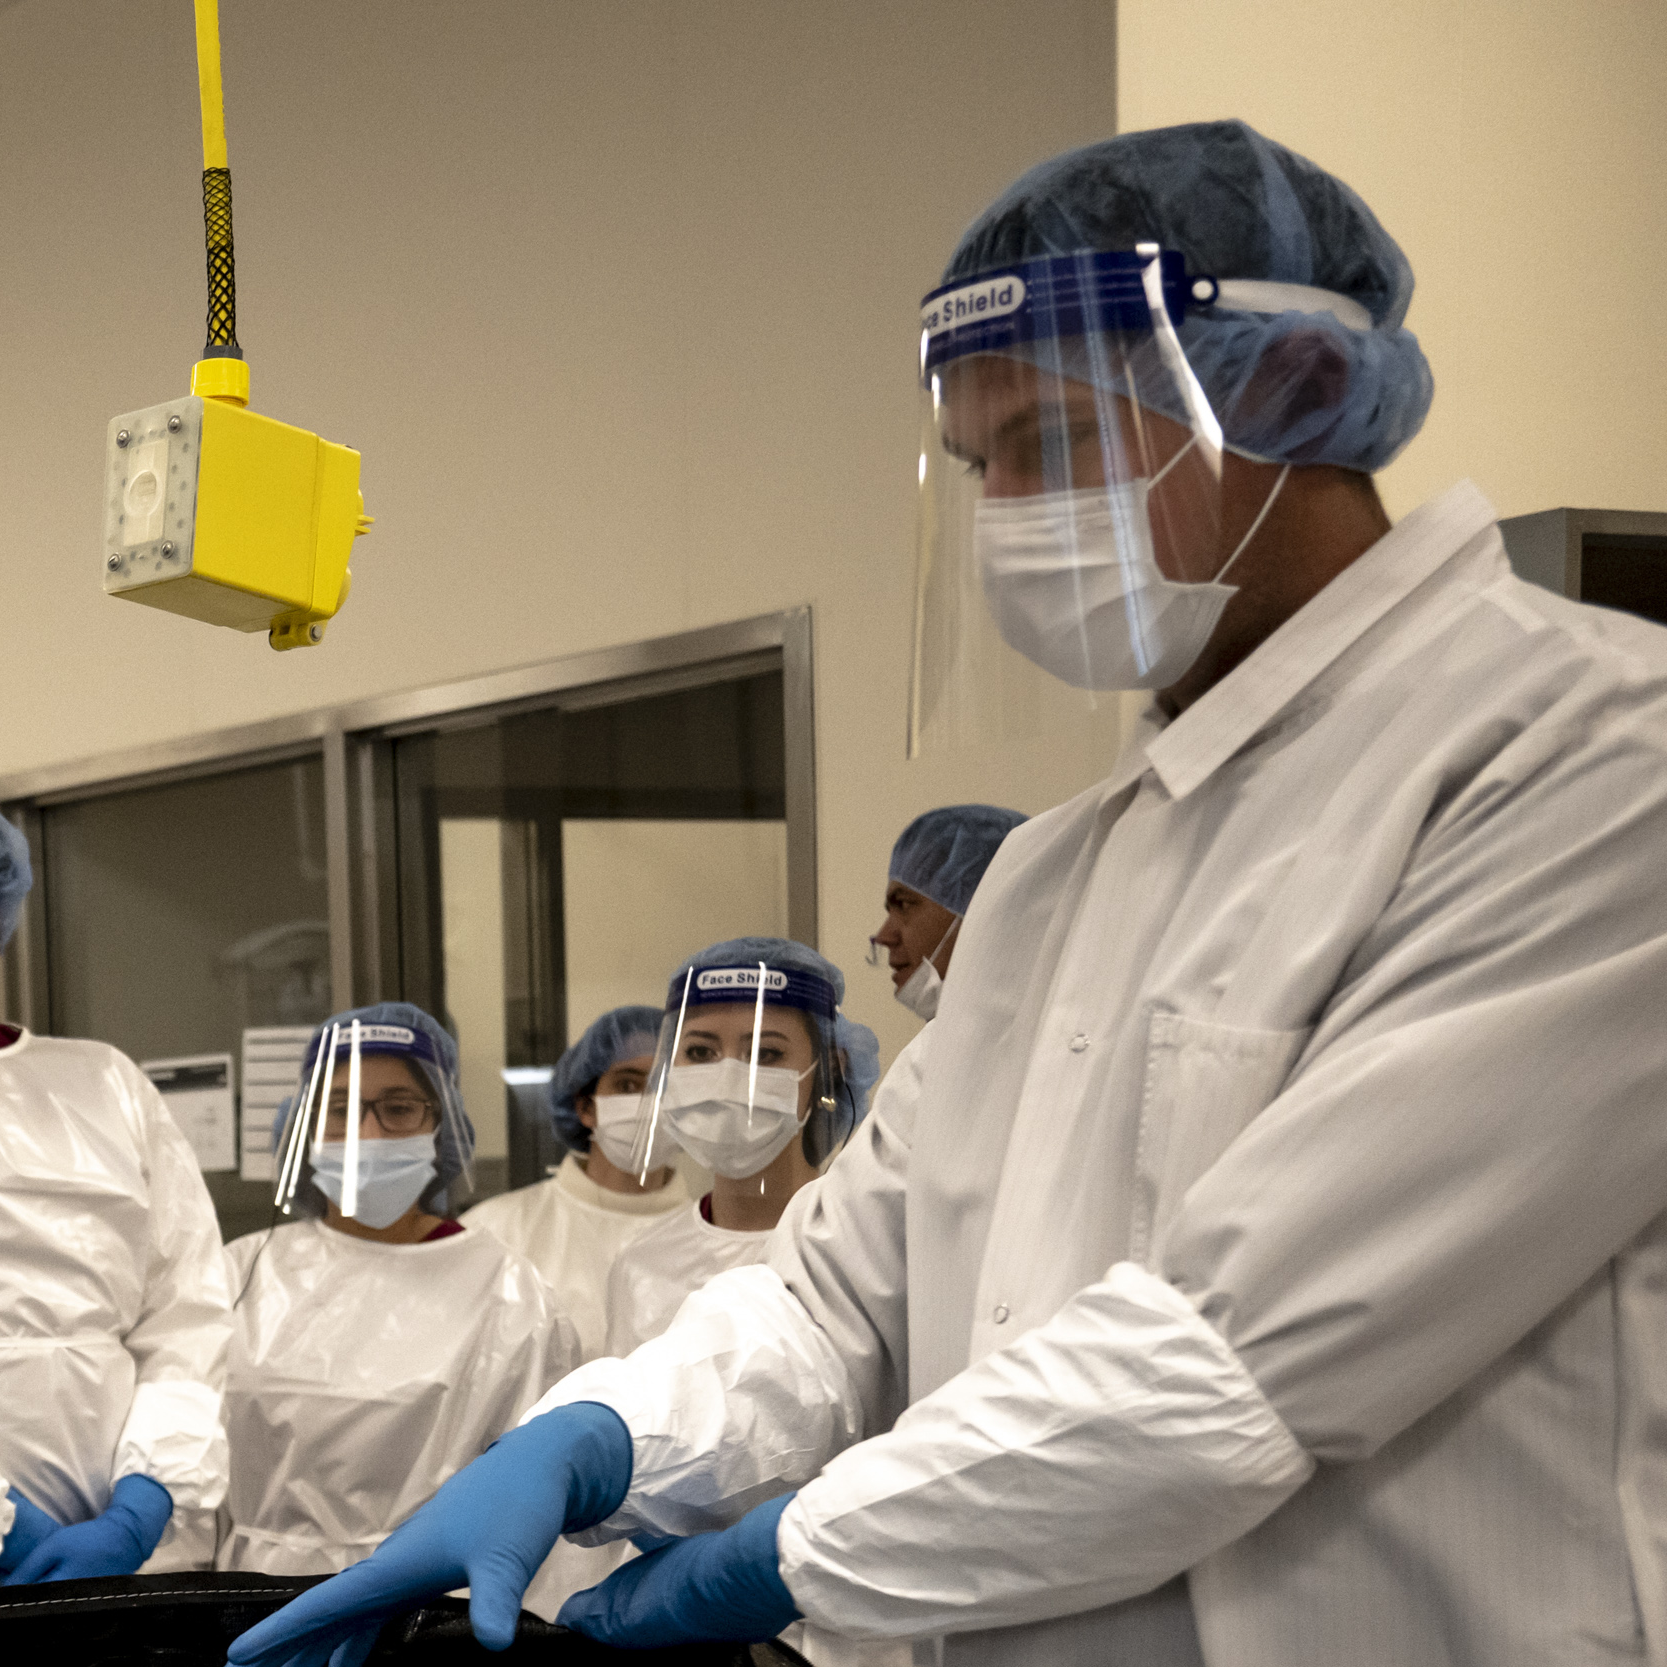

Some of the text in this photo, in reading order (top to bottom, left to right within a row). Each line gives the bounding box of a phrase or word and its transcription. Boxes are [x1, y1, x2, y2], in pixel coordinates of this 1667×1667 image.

[942, 284, 1013, 323] Shield
[702, 974, 732, 985] Face
[737, 972, 782, 986] Shild
